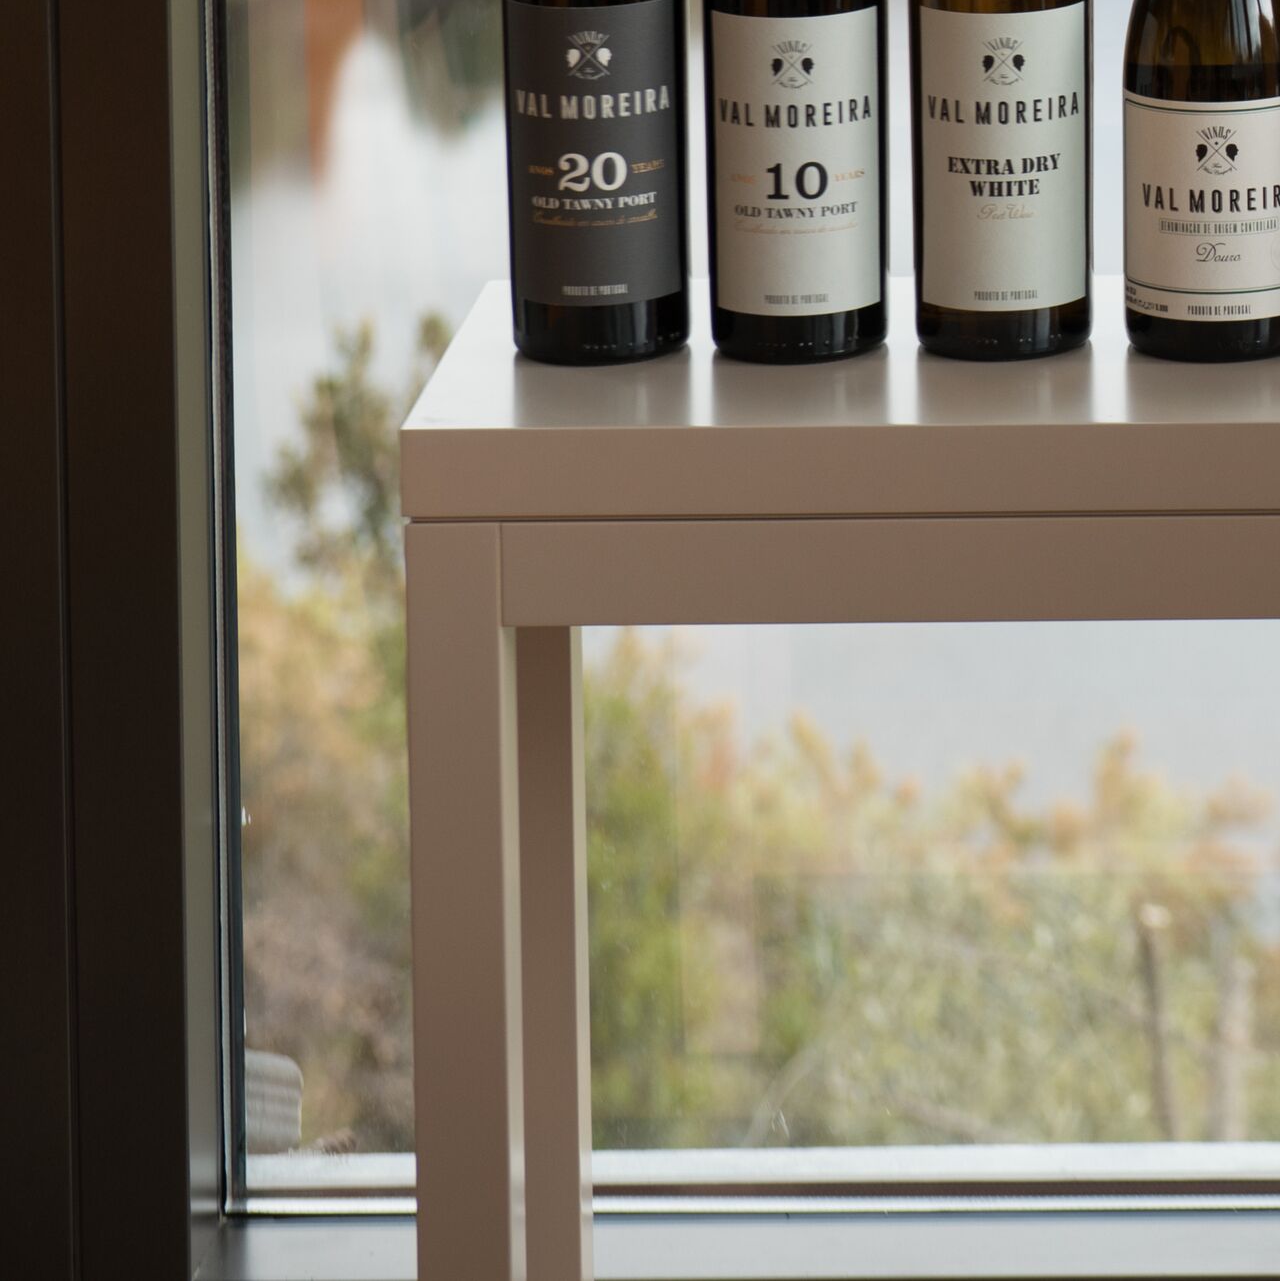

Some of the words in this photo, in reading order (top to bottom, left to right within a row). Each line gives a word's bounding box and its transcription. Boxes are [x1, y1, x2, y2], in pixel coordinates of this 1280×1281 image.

[514, 89, 552, 119] VAL
[559, 85, 670, 120] MOREIRA
[719, 97, 755, 127] VAL
[764, 95, 872, 129] MOREIRA
[927, 95, 965, 124] VAL
[975, 91, 1079, 125] MOREIRA
[1201, 125, 1232, 140] VINUS
[557, 151, 628, 193] 20
[947, 156, 1015, 175] EXTRA
[1021, 152, 1061, 174] DRY
[765, 161, 829, 200] 10
[969, 178, 1040, 198] WHITE
[531, 195, 560, 209] OLD
[562, 198, 616, 211] TAWNY
[618, 192, 657, 208] PORT
[1142, 183, 1178, 212] VAL
[734, 204, 761, 218] OLD
[764, 207, 816, 219] TAWNY
[820, 201, 858, 217] PORT
[1203, 222, 1211, 234] DE
[1214, 222, 1238, 234] ORIGEM
[1240, 219, 1278, 234] CONTROLADA
[1195, 242, 1242, 263] Douro
[1001, 290, 1009, 301] DE
[1010, 289, 1039, 301] PORTUGAL
[1187, 305, 1212, 316] PRODUTO
[1214, 305, 1222, 316] DE
[1223, 304, 1252, 316] PORTUGAL
